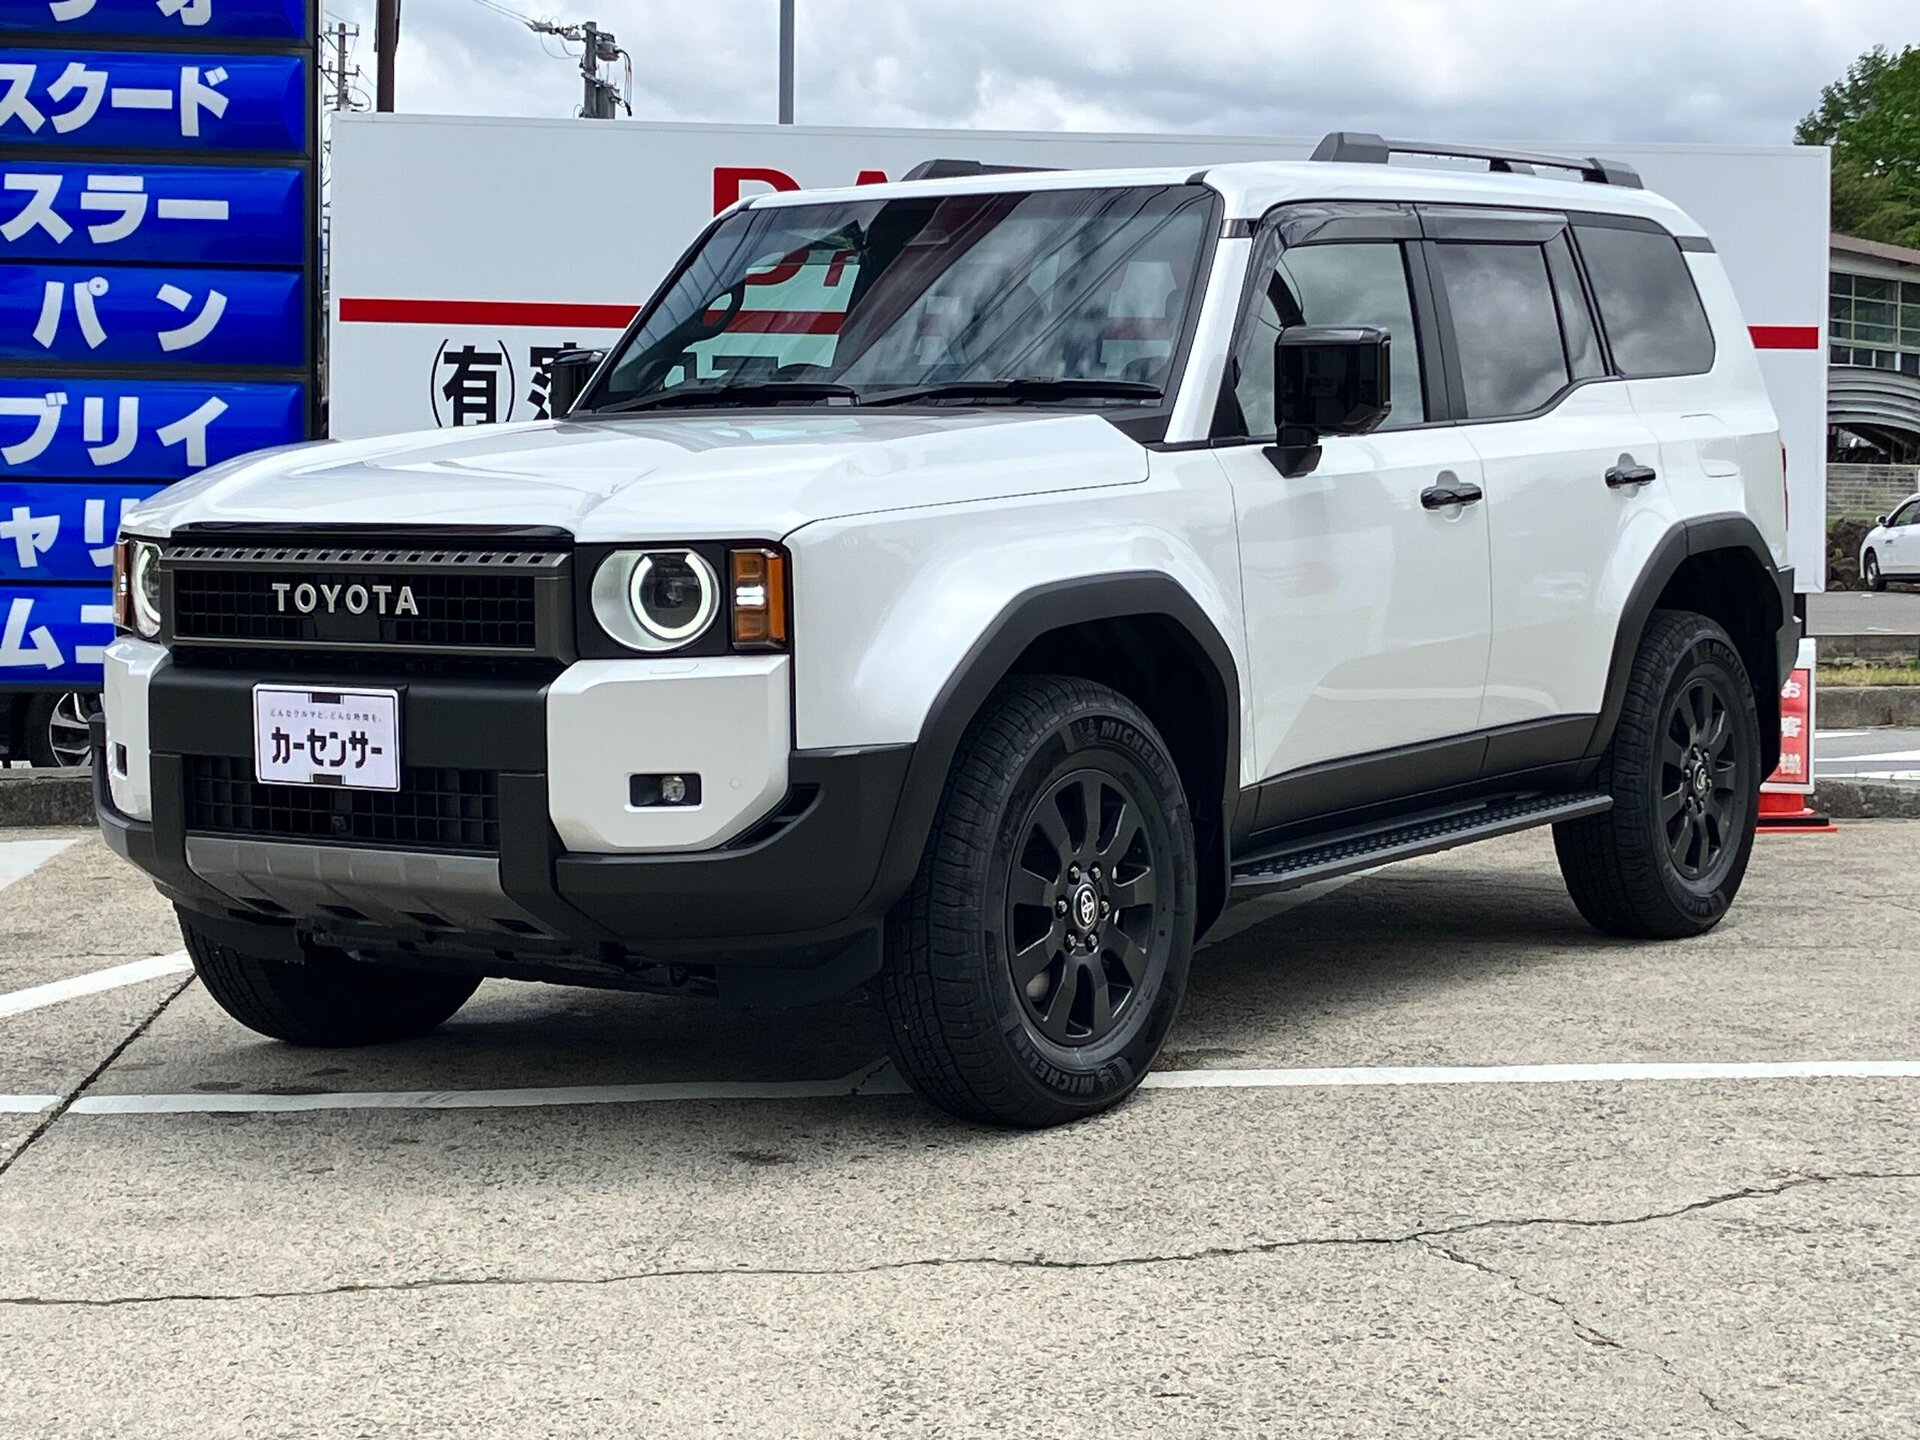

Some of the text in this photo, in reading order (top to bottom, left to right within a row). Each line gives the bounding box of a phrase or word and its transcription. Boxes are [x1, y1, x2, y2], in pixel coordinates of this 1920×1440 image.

[0, 62, 229, 137] スクード
[0, 173, 229, 244] スラー
[32, 276, 228, 352] パン
[0, 392, 229, 467] ブリイ
[271, 583, 419, 616] TOYOTA
[271, 726, 383, 769] カーセンサー
